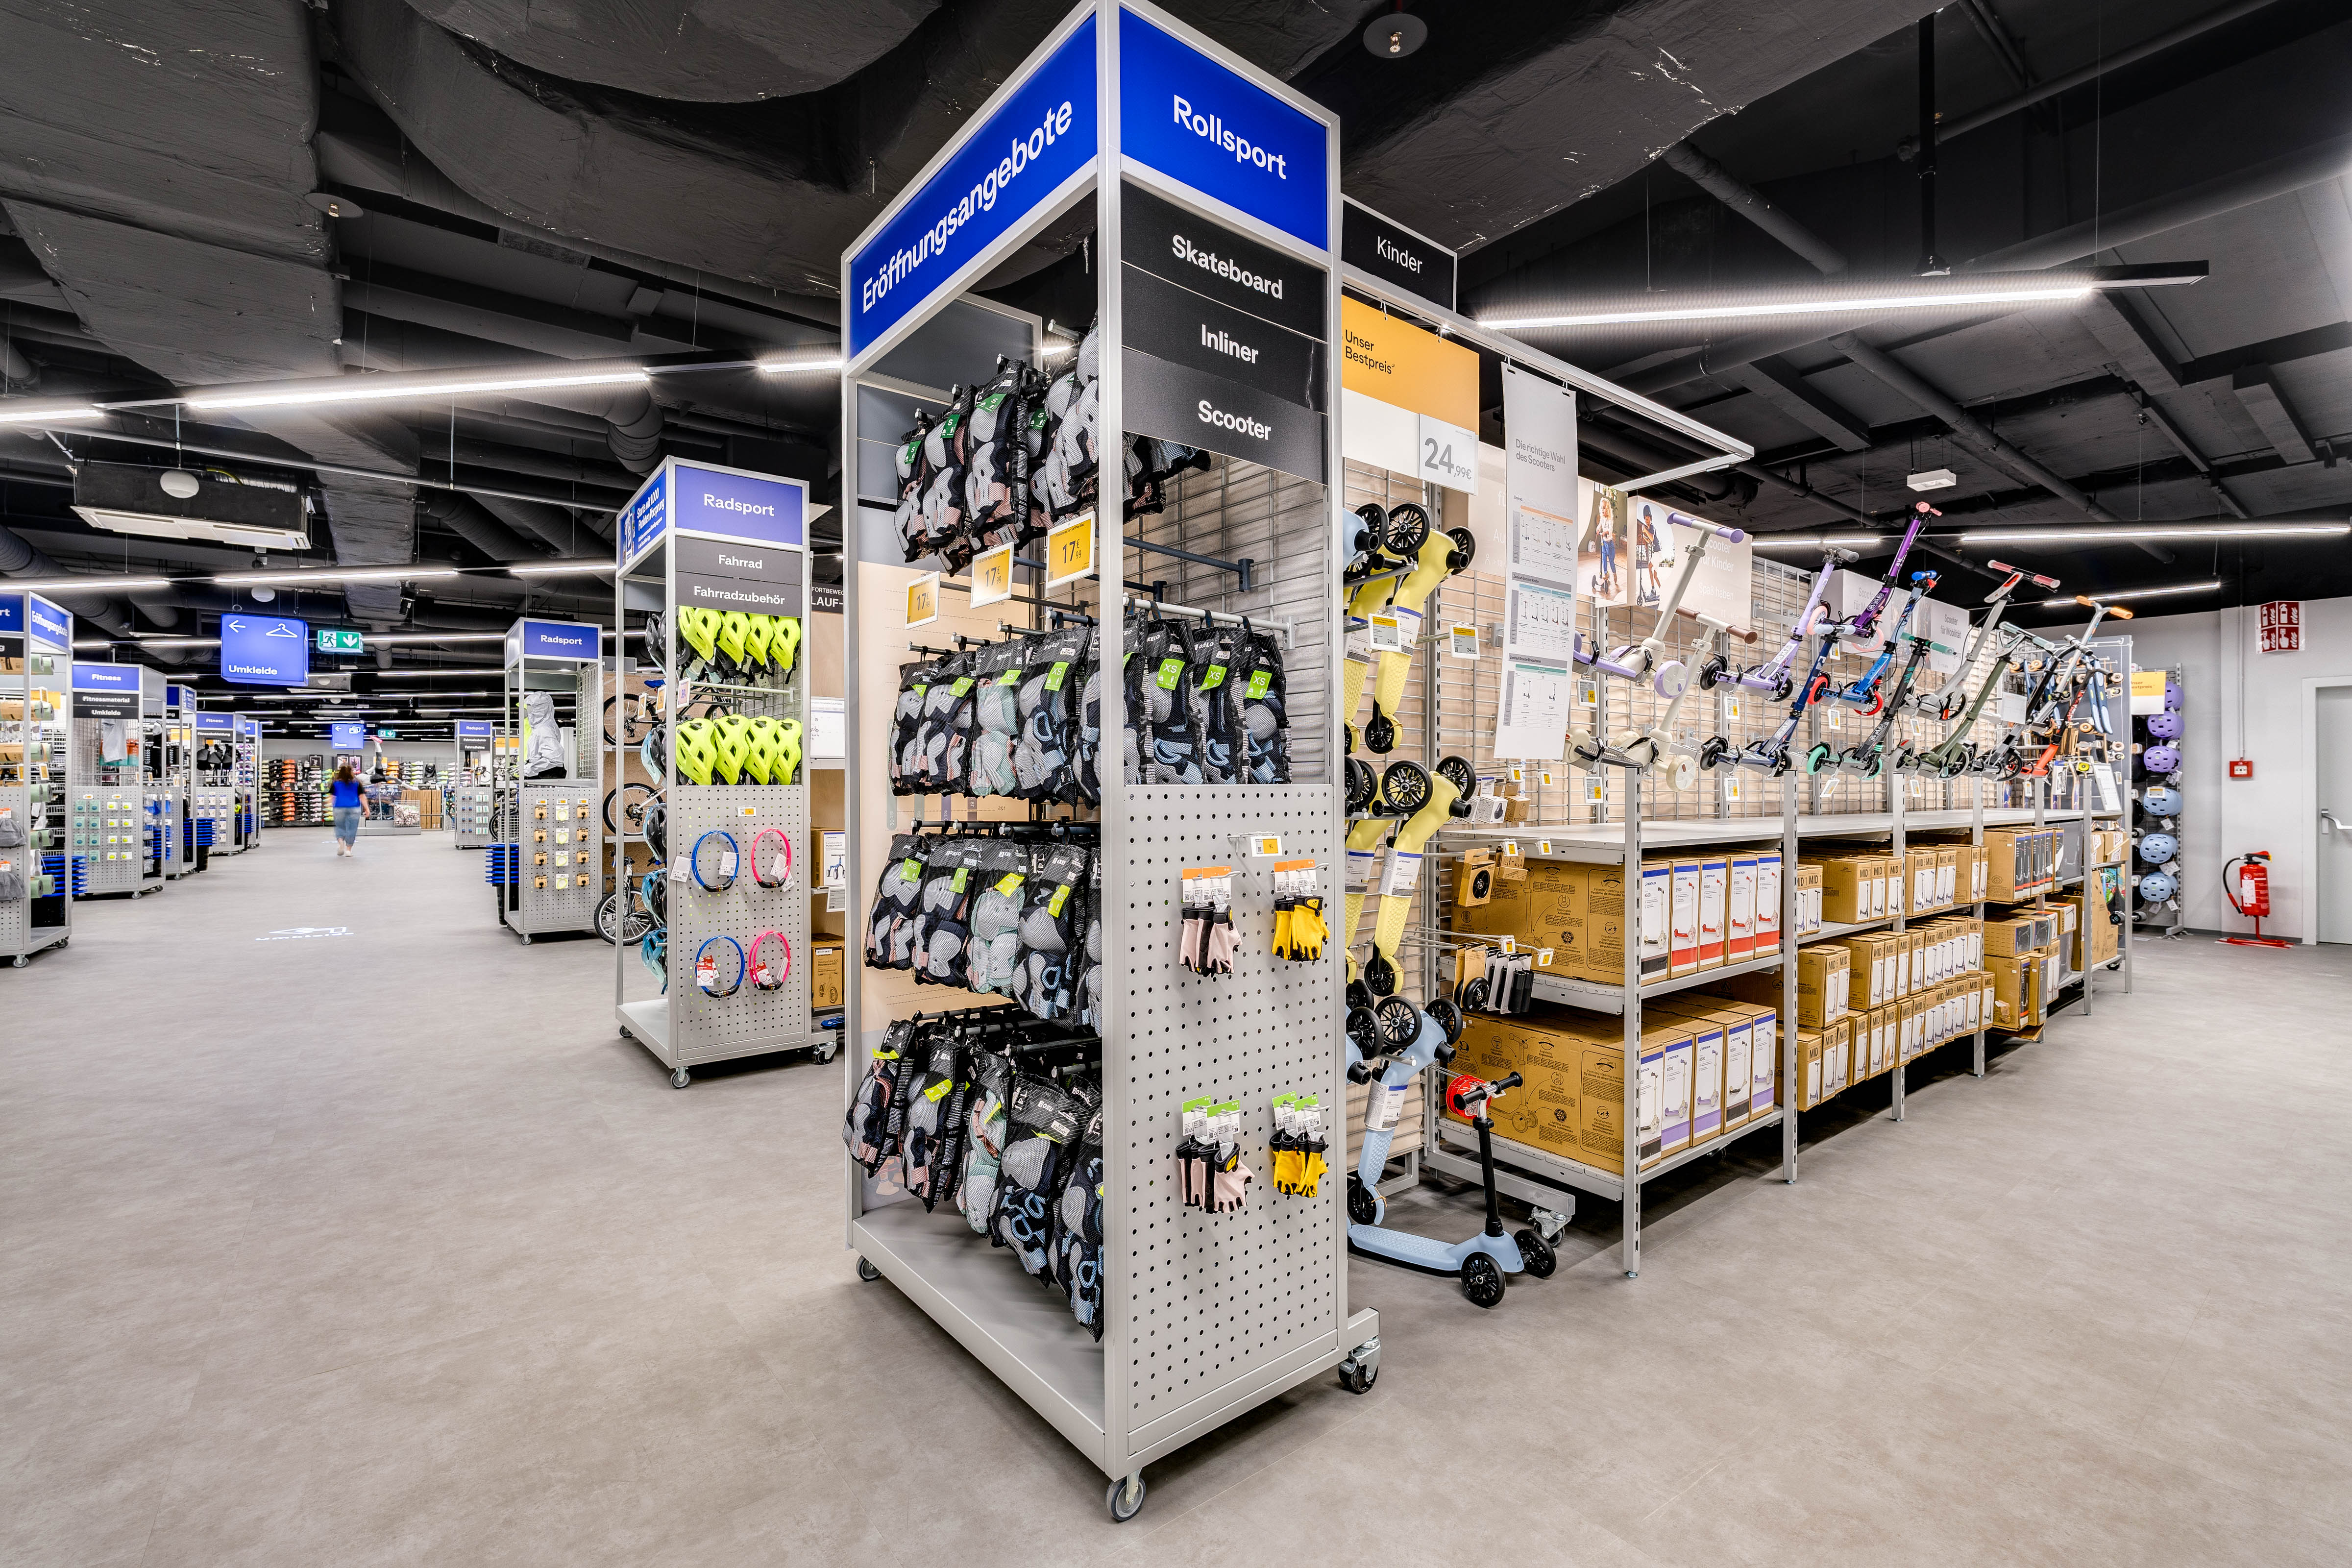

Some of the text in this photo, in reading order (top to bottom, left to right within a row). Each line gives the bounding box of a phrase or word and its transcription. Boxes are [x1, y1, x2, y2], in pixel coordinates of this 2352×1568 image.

[1174, 94, 1286, 180] Rollsport
[863, 101, 1072, 314] Eröffnungsangebote
[1377, 236, 1422, 274] Kinder
[1172, 235, 1282, 299] Skateboard
[1202, 324, 1259, 364] Inliner
[1345, 329, 1374, 352] Unser
[1345, 346, 1392, 374] Bestpreis
[1198, 400, 1271, 441] Scooter
[1516, 439, 1566, 465] Die richtige Wahl
[1425, 438, 1472, 480] 24,99€
[1516, 451, 1555, 472] des Scooters
[704, 493, 775, 516] Radsport
[1063, 540, 1076, 564] 17
[1076, 550, 1081, 559] 99
[718, 554, 763, 569] Fahrrad
[1712, 556, 1734, 573] Kinder
[985, 567, 997, 587] 17
[694, 586, 785, 605] Fahrradzubehör
[1716, 587, 1734, 600] haben
[917, 593, 927, 611] 17
[1944, 614, 1959, 626] Scooter
[1946, 627, 1961, 639] Mobilität
[540, 635, 582, 645] Radsport
[229, 665, 278, 675] Umkleide
[1163, 663, 1177, 673] XS
[1208, 671, 1221, 680] XS
[1253, 676, 1266, 686] XS
[907, 861, 918, 869] XS
[1874, 867, 1882, 876] MID
[1890, 865, 1899, 874] MID
[1809, 875, 1818, 884] MID
[1860, 869, 1868, 878] MID
[1054, 892, 1066, 901] 2XS
[1839, 956, 1848, 966] MID
[1810, 1048, 1818, 1058] MID
[937, 1082, 949, 1094] 2XS
[1054, 1125, 1066, 1135] ENFANT
